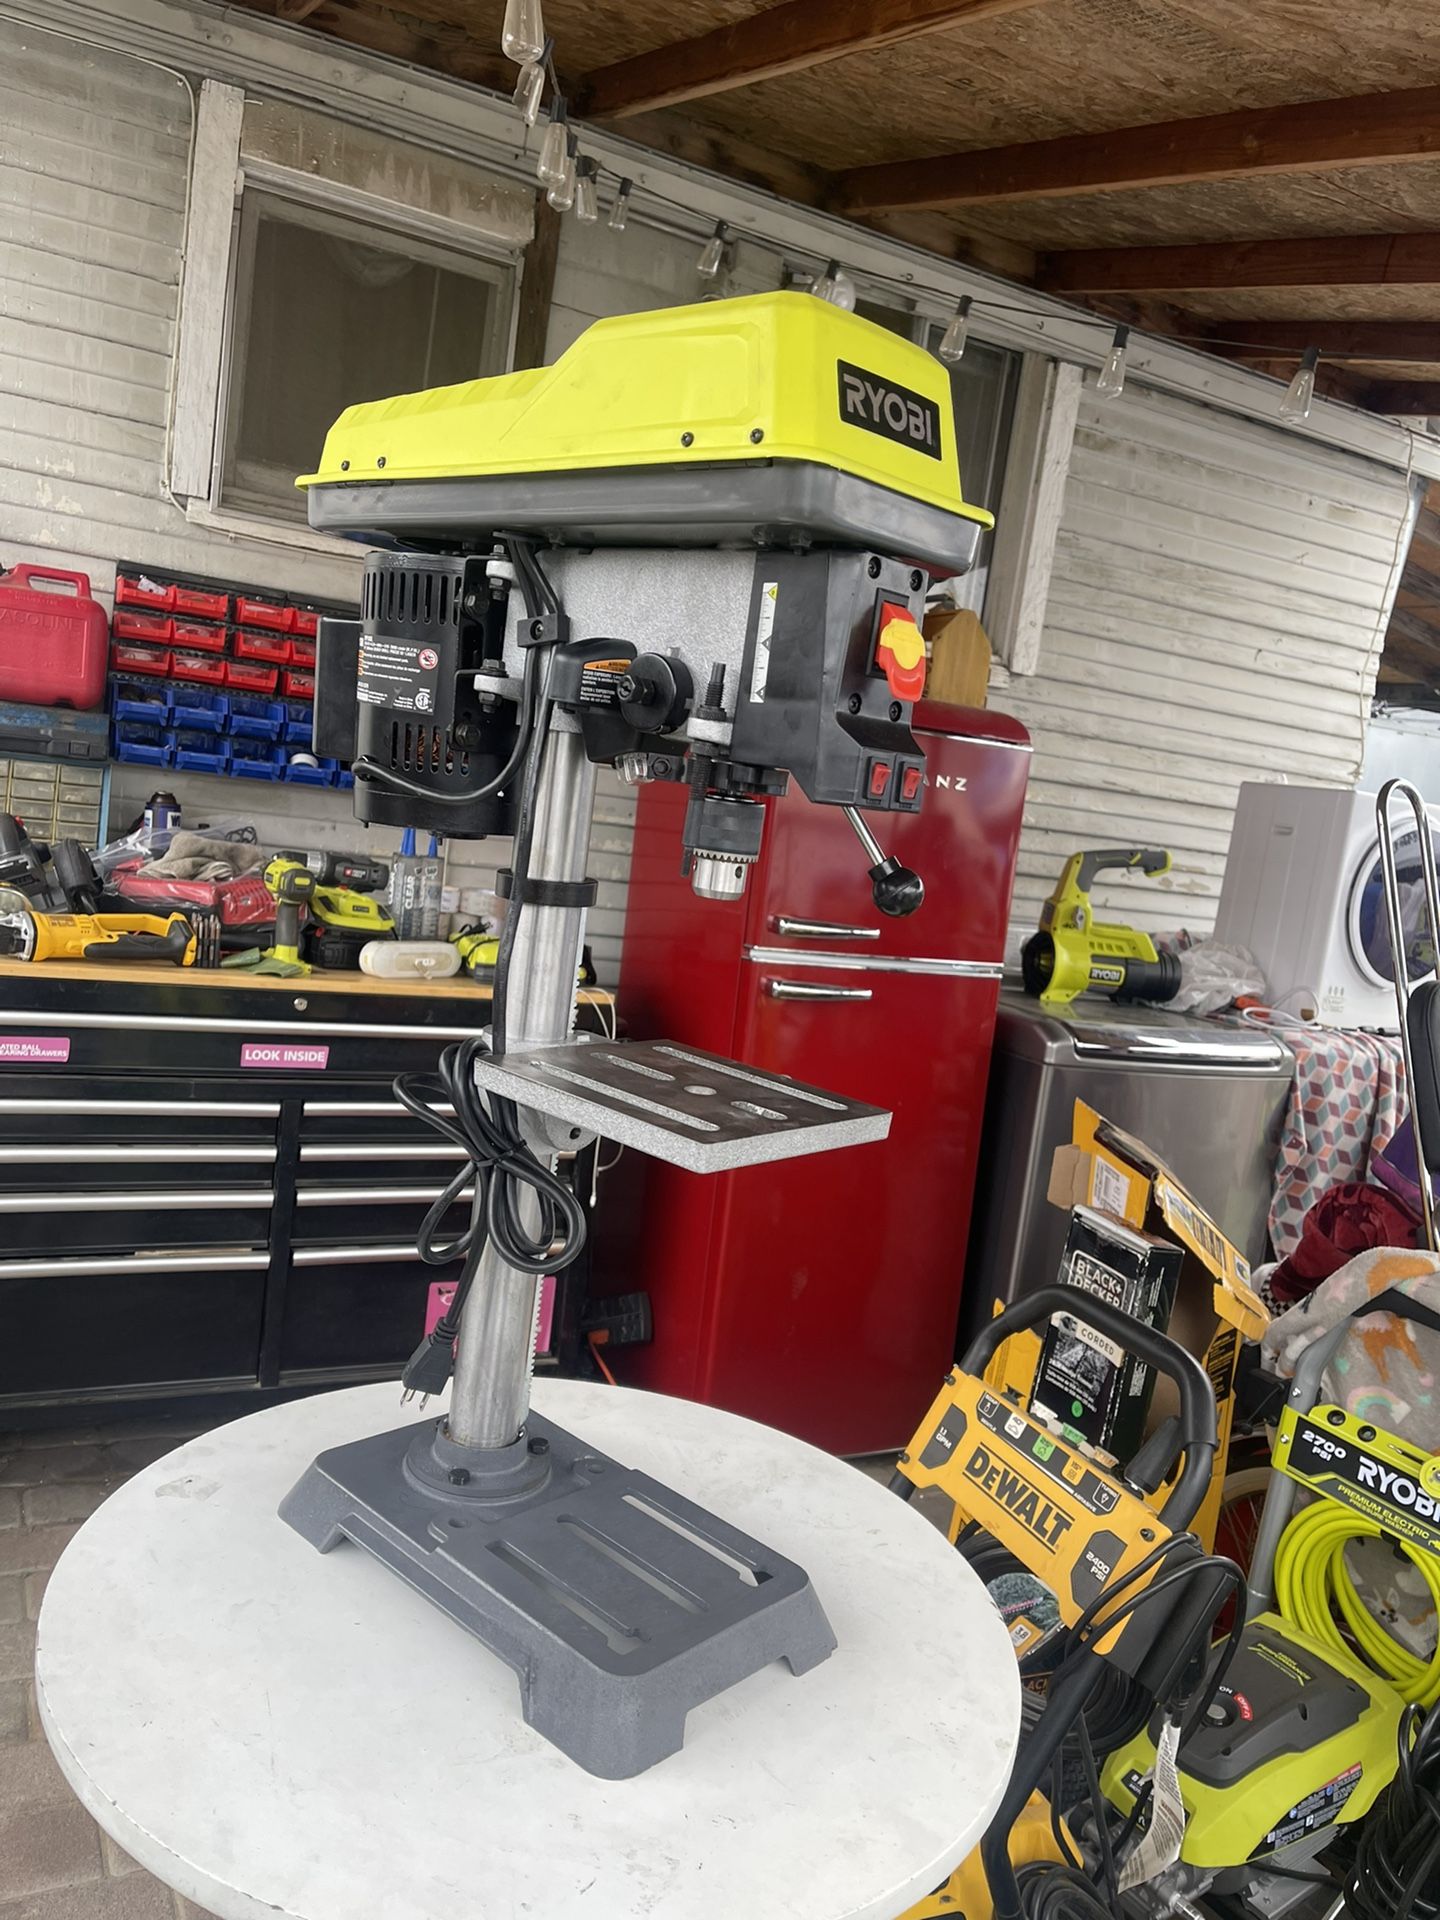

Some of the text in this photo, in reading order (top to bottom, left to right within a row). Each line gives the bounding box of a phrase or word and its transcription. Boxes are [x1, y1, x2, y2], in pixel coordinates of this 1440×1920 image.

[843, 373, 933, 446] RYOBI
[1091, 968, 1120, 981] RYOBI
[21, 1043, 39, 1051] BALL
[30, 1049, 67, 1057] DRAWERS
[245, 1049, 325, 1063] LOOK INSIDE
[1081, 1328, 1114, 1356] CORDED
[935, 1432, 952, 1449] GPM
[1302, 1430, 1347, 1459] 2700
[1311, 1446, 1332, 1461] PSI
[1337, 1484, 1430, 1539] PREMIUM ELECTRIC
[1348, 1498, 1415, 1537] PRESSURE WASHER
[1085, 1551, 1110, 1575] 2400
[1090, 1565, 1106, 1582] PSI
[1219, 1686, 1233, 1694] ON
